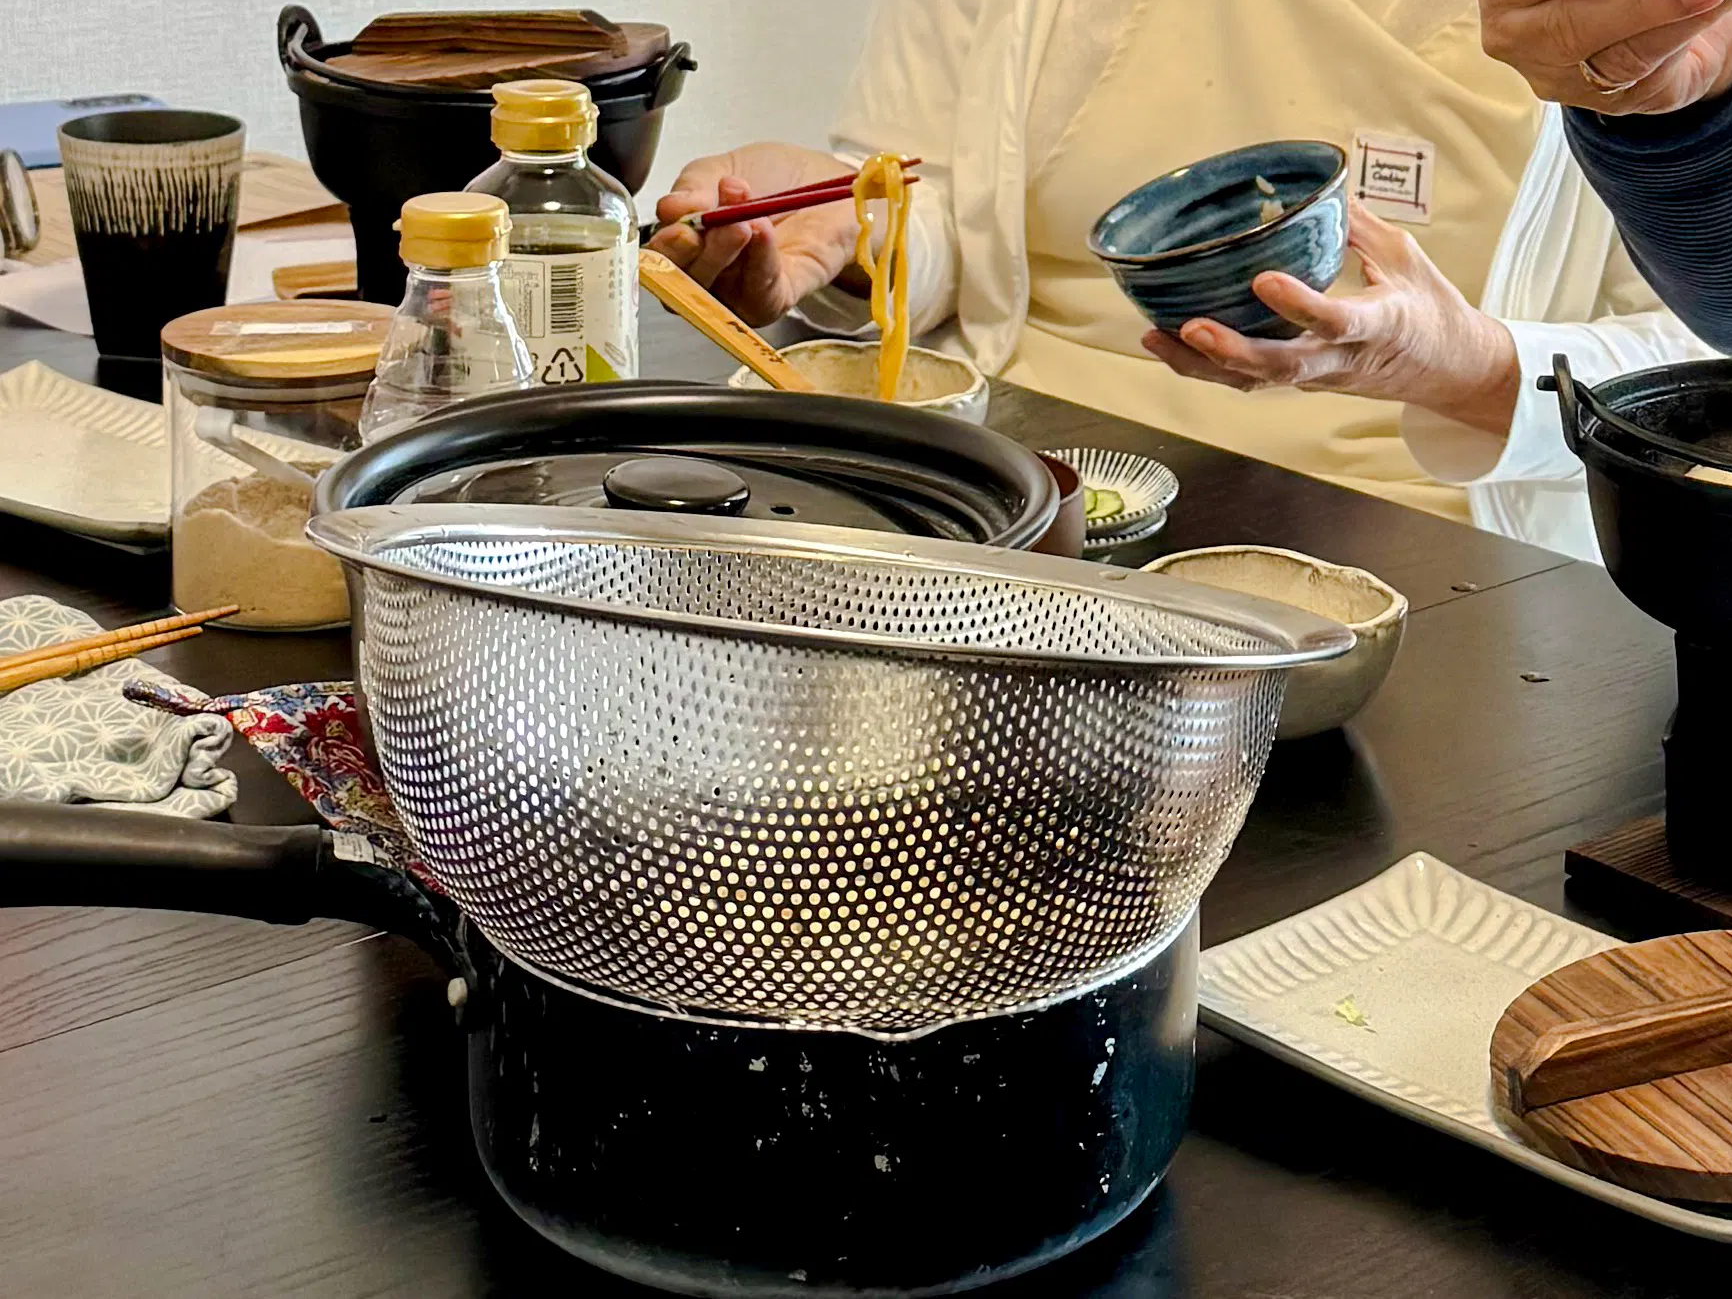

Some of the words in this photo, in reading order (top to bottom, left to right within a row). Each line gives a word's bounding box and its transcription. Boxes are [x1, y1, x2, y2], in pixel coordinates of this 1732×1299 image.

[1370, 158, 1411, 172] Japanese
[1372, 171, 1406, 188] Cooking
[559, 362, 565, 377] 1
